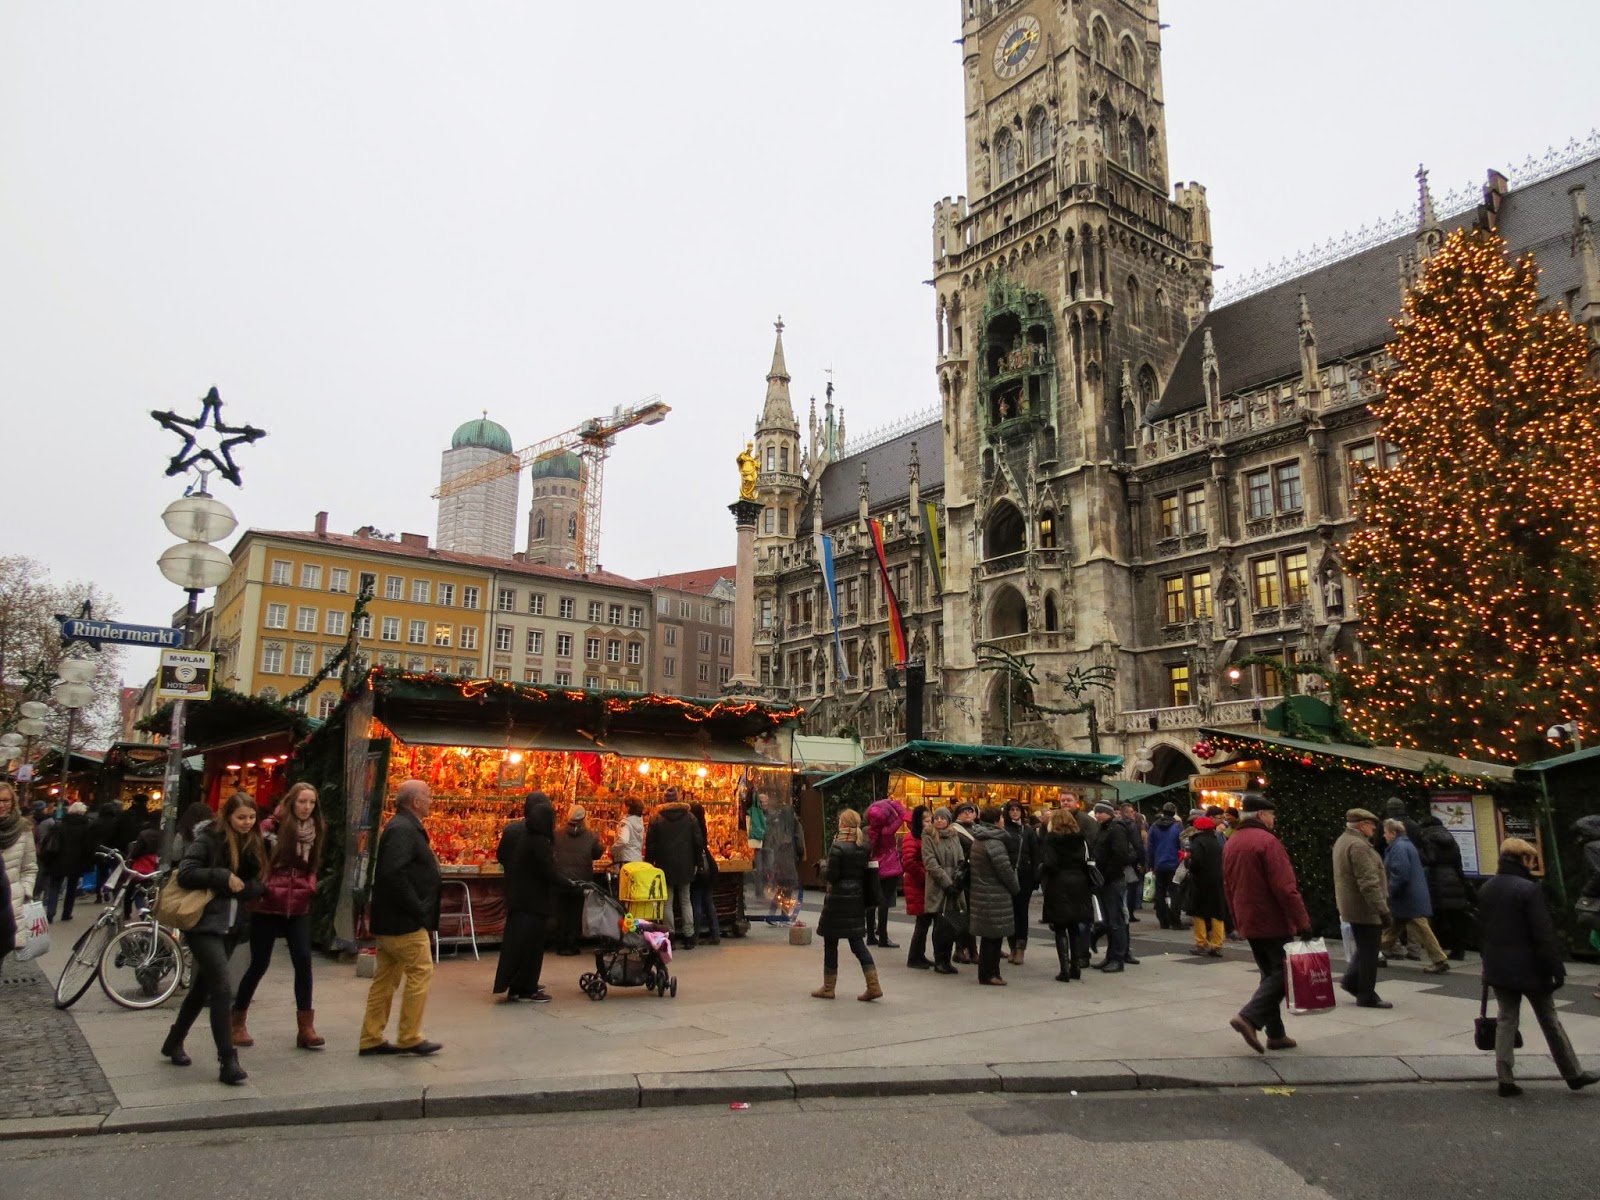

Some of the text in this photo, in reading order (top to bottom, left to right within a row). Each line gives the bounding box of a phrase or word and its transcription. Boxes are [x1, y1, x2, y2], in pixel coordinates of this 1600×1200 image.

[73, 622, 174, 644] Rindermarkt
[170, 655, 205, 663] M-WLAN
[1194, 776, 1241, 788] Glühwein
